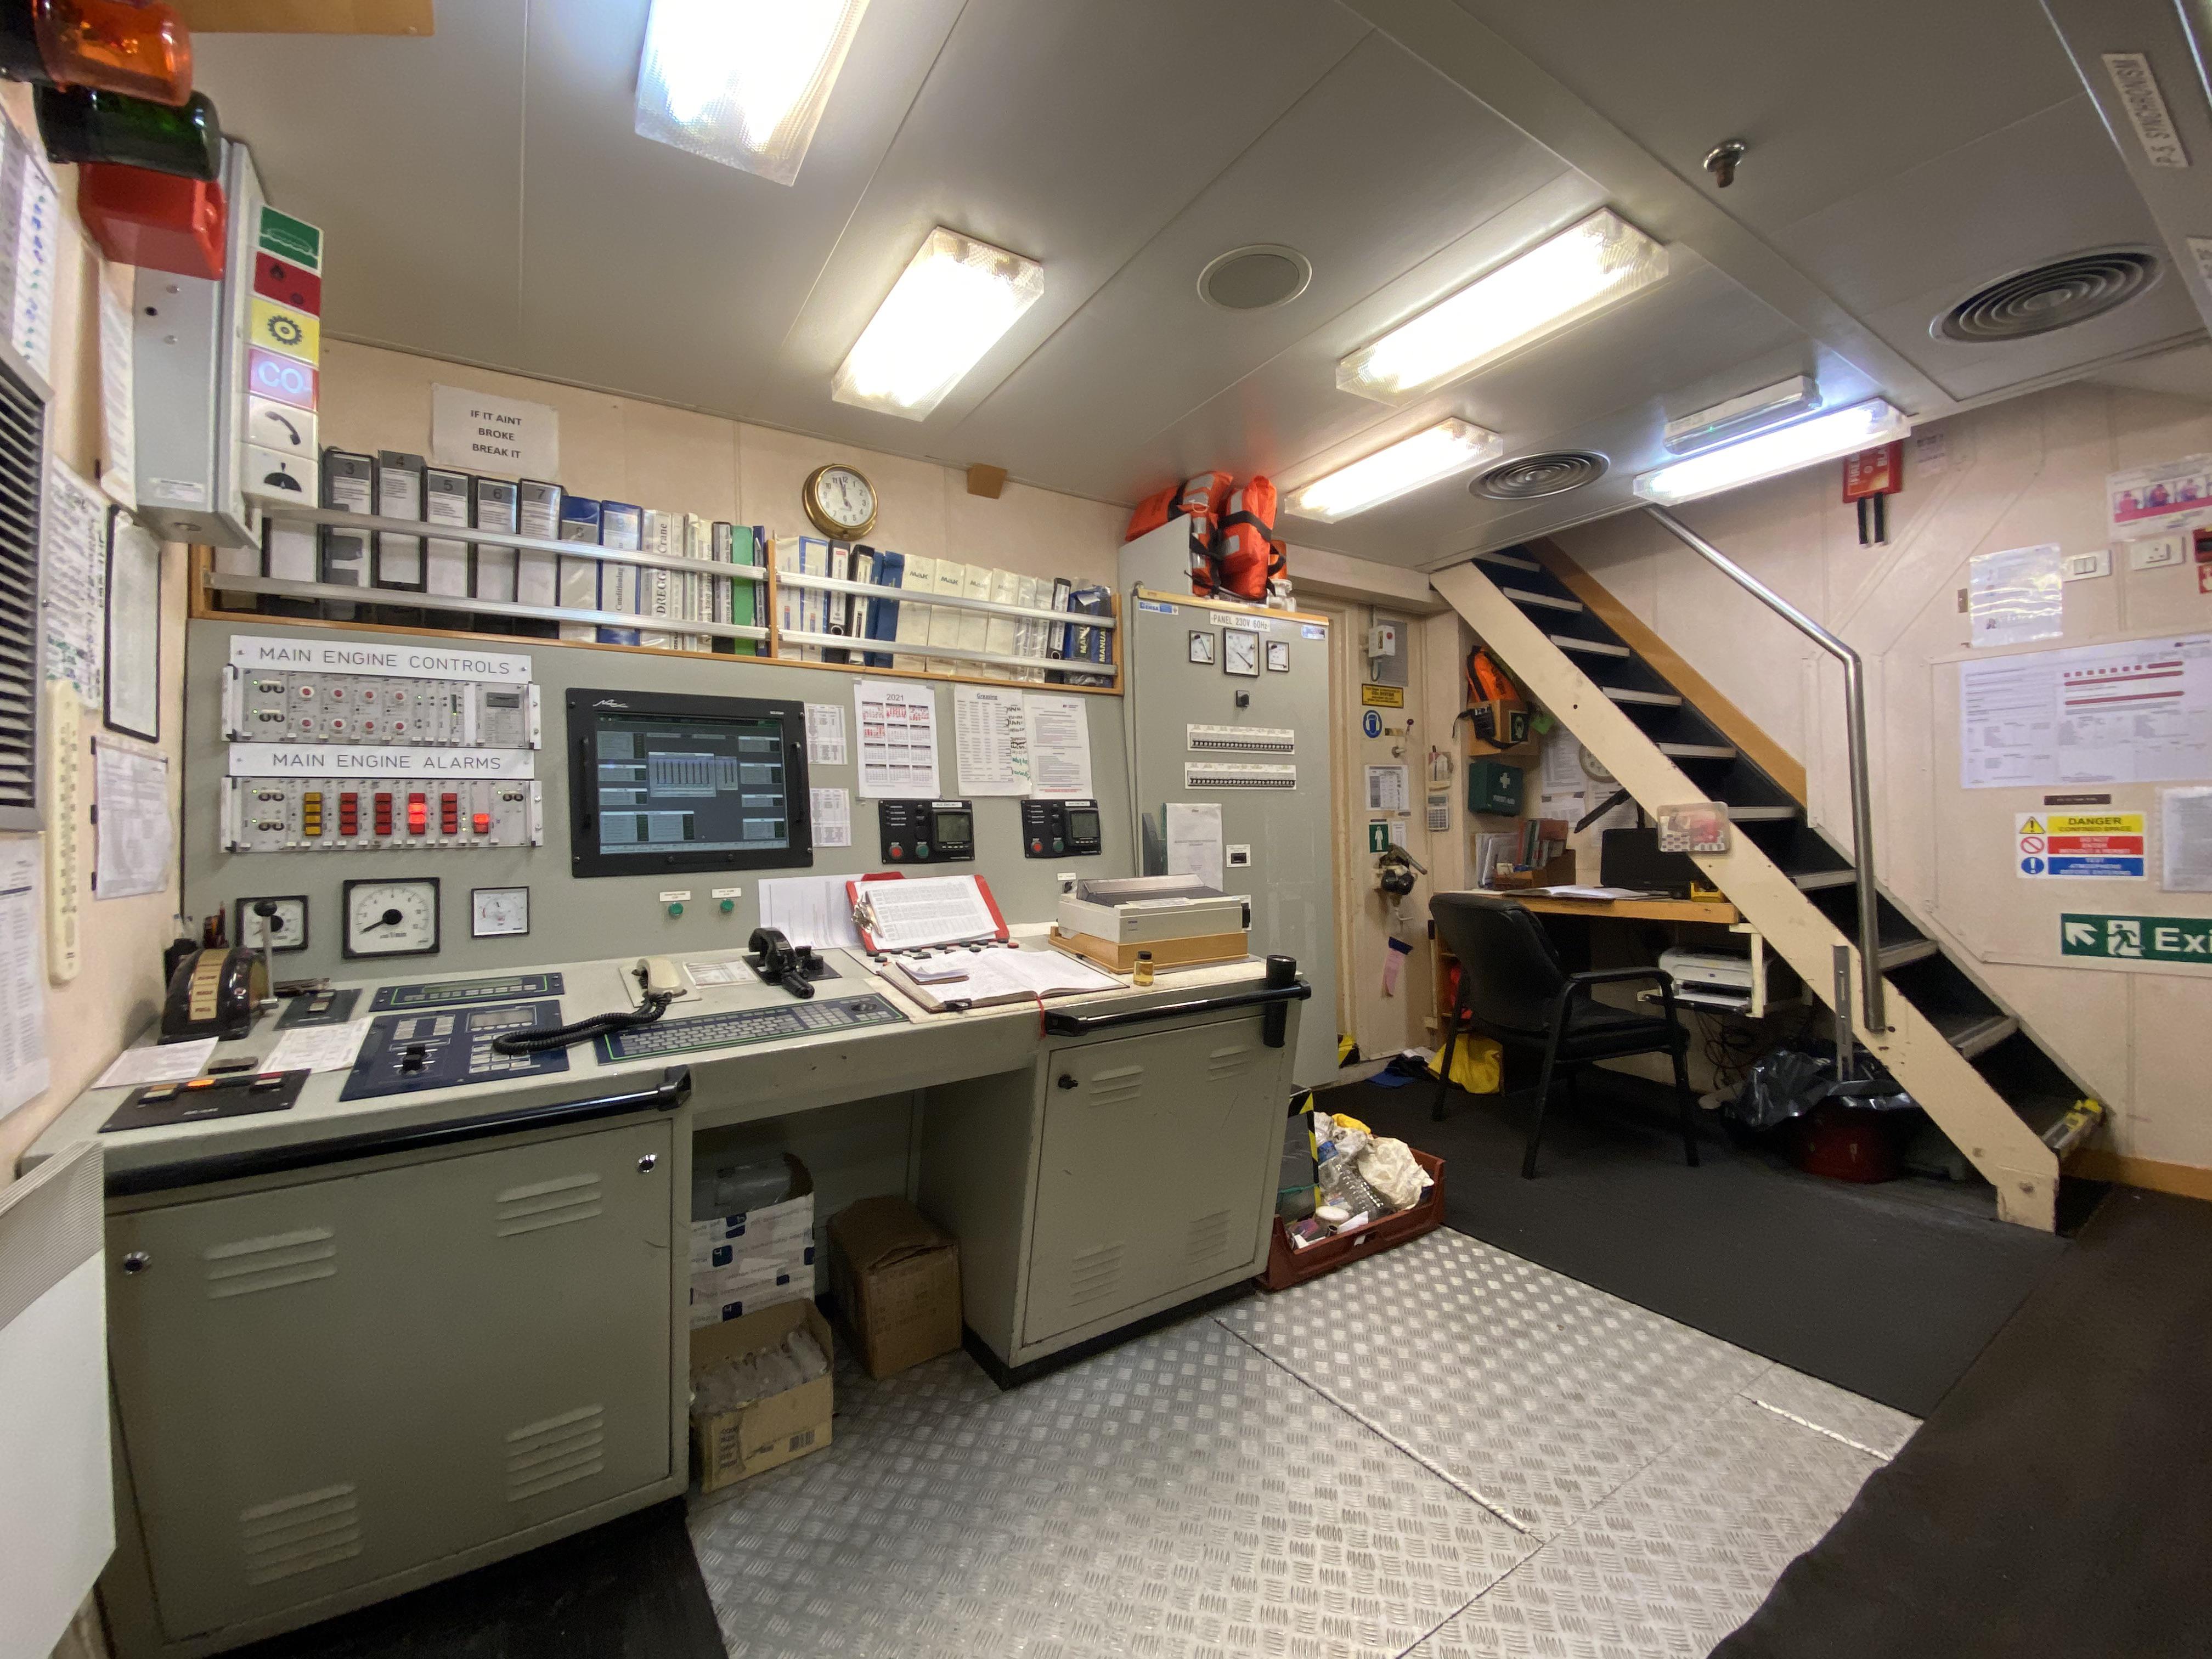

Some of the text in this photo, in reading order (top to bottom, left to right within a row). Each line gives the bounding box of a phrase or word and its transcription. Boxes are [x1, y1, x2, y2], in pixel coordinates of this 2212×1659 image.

[470, 409, 522, 426] IF IT AINT
[478, 427, 515, 441] BROKE
[472, 443, 522, 459] BREAK IT
[345, 461, 355, 475] 3
[395, 456, 405, 467] 4
[443, 479, 453, 492] 5
[493, 489, 503, 499] 6
[537, 489, 545, 500] 7
[656, 523, 668, 614] DREGG Crane
[1213, 614, 1268, 629] PANEL 230V 60Hz
[1079, 627, 1087, 654] MANU
[260, 647, 510, 675] MAIN ENGINE CONTROLS
[886, 693, 904, 701] 2021
[273, 753, 501, 770] MAIN ENGINE ALARMS
[2068, 817, 2121, 825] DANGER
